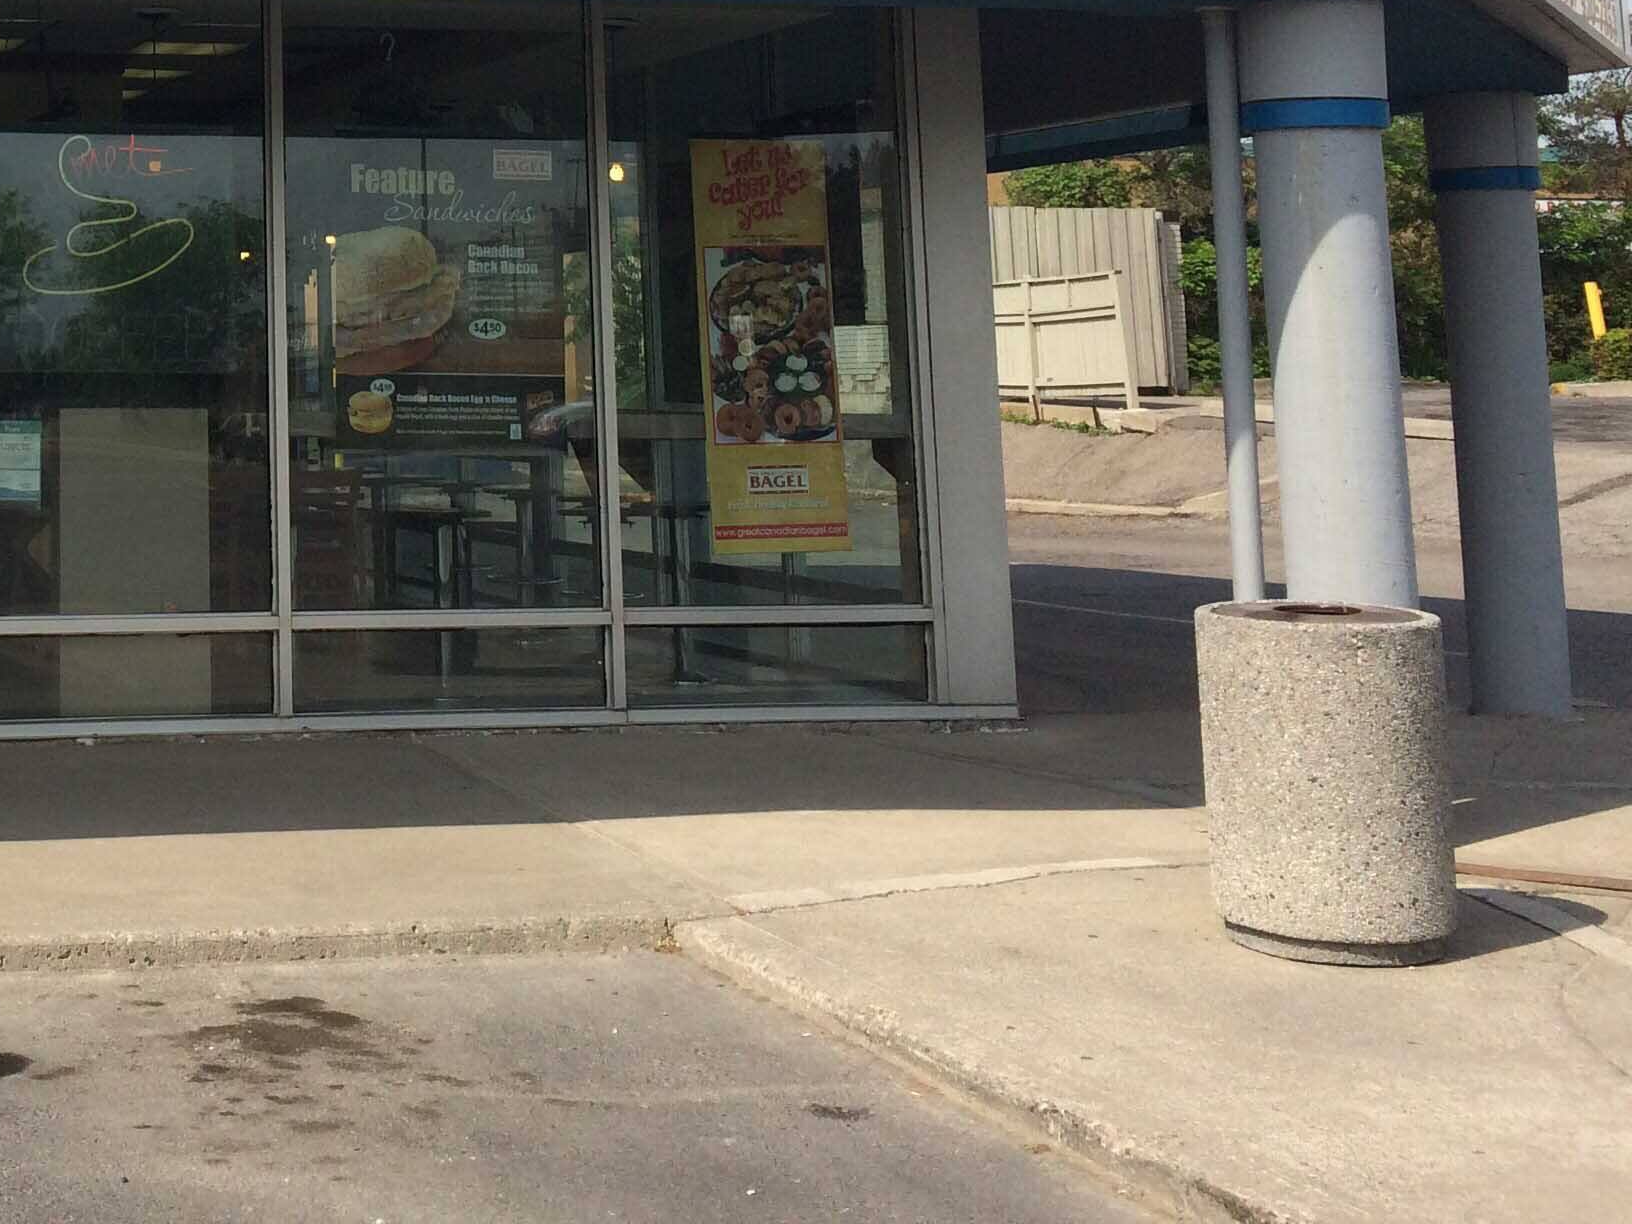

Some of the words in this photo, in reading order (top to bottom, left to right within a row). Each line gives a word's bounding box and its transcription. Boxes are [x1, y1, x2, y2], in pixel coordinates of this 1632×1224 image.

[350, 162, 456, 195] Feature
[383, 188, 537, 225] Sandwiches
[749, 475, 808, 489] BAGEL
[716, 524, 848, 539] www.greatcanadianbagel.com
